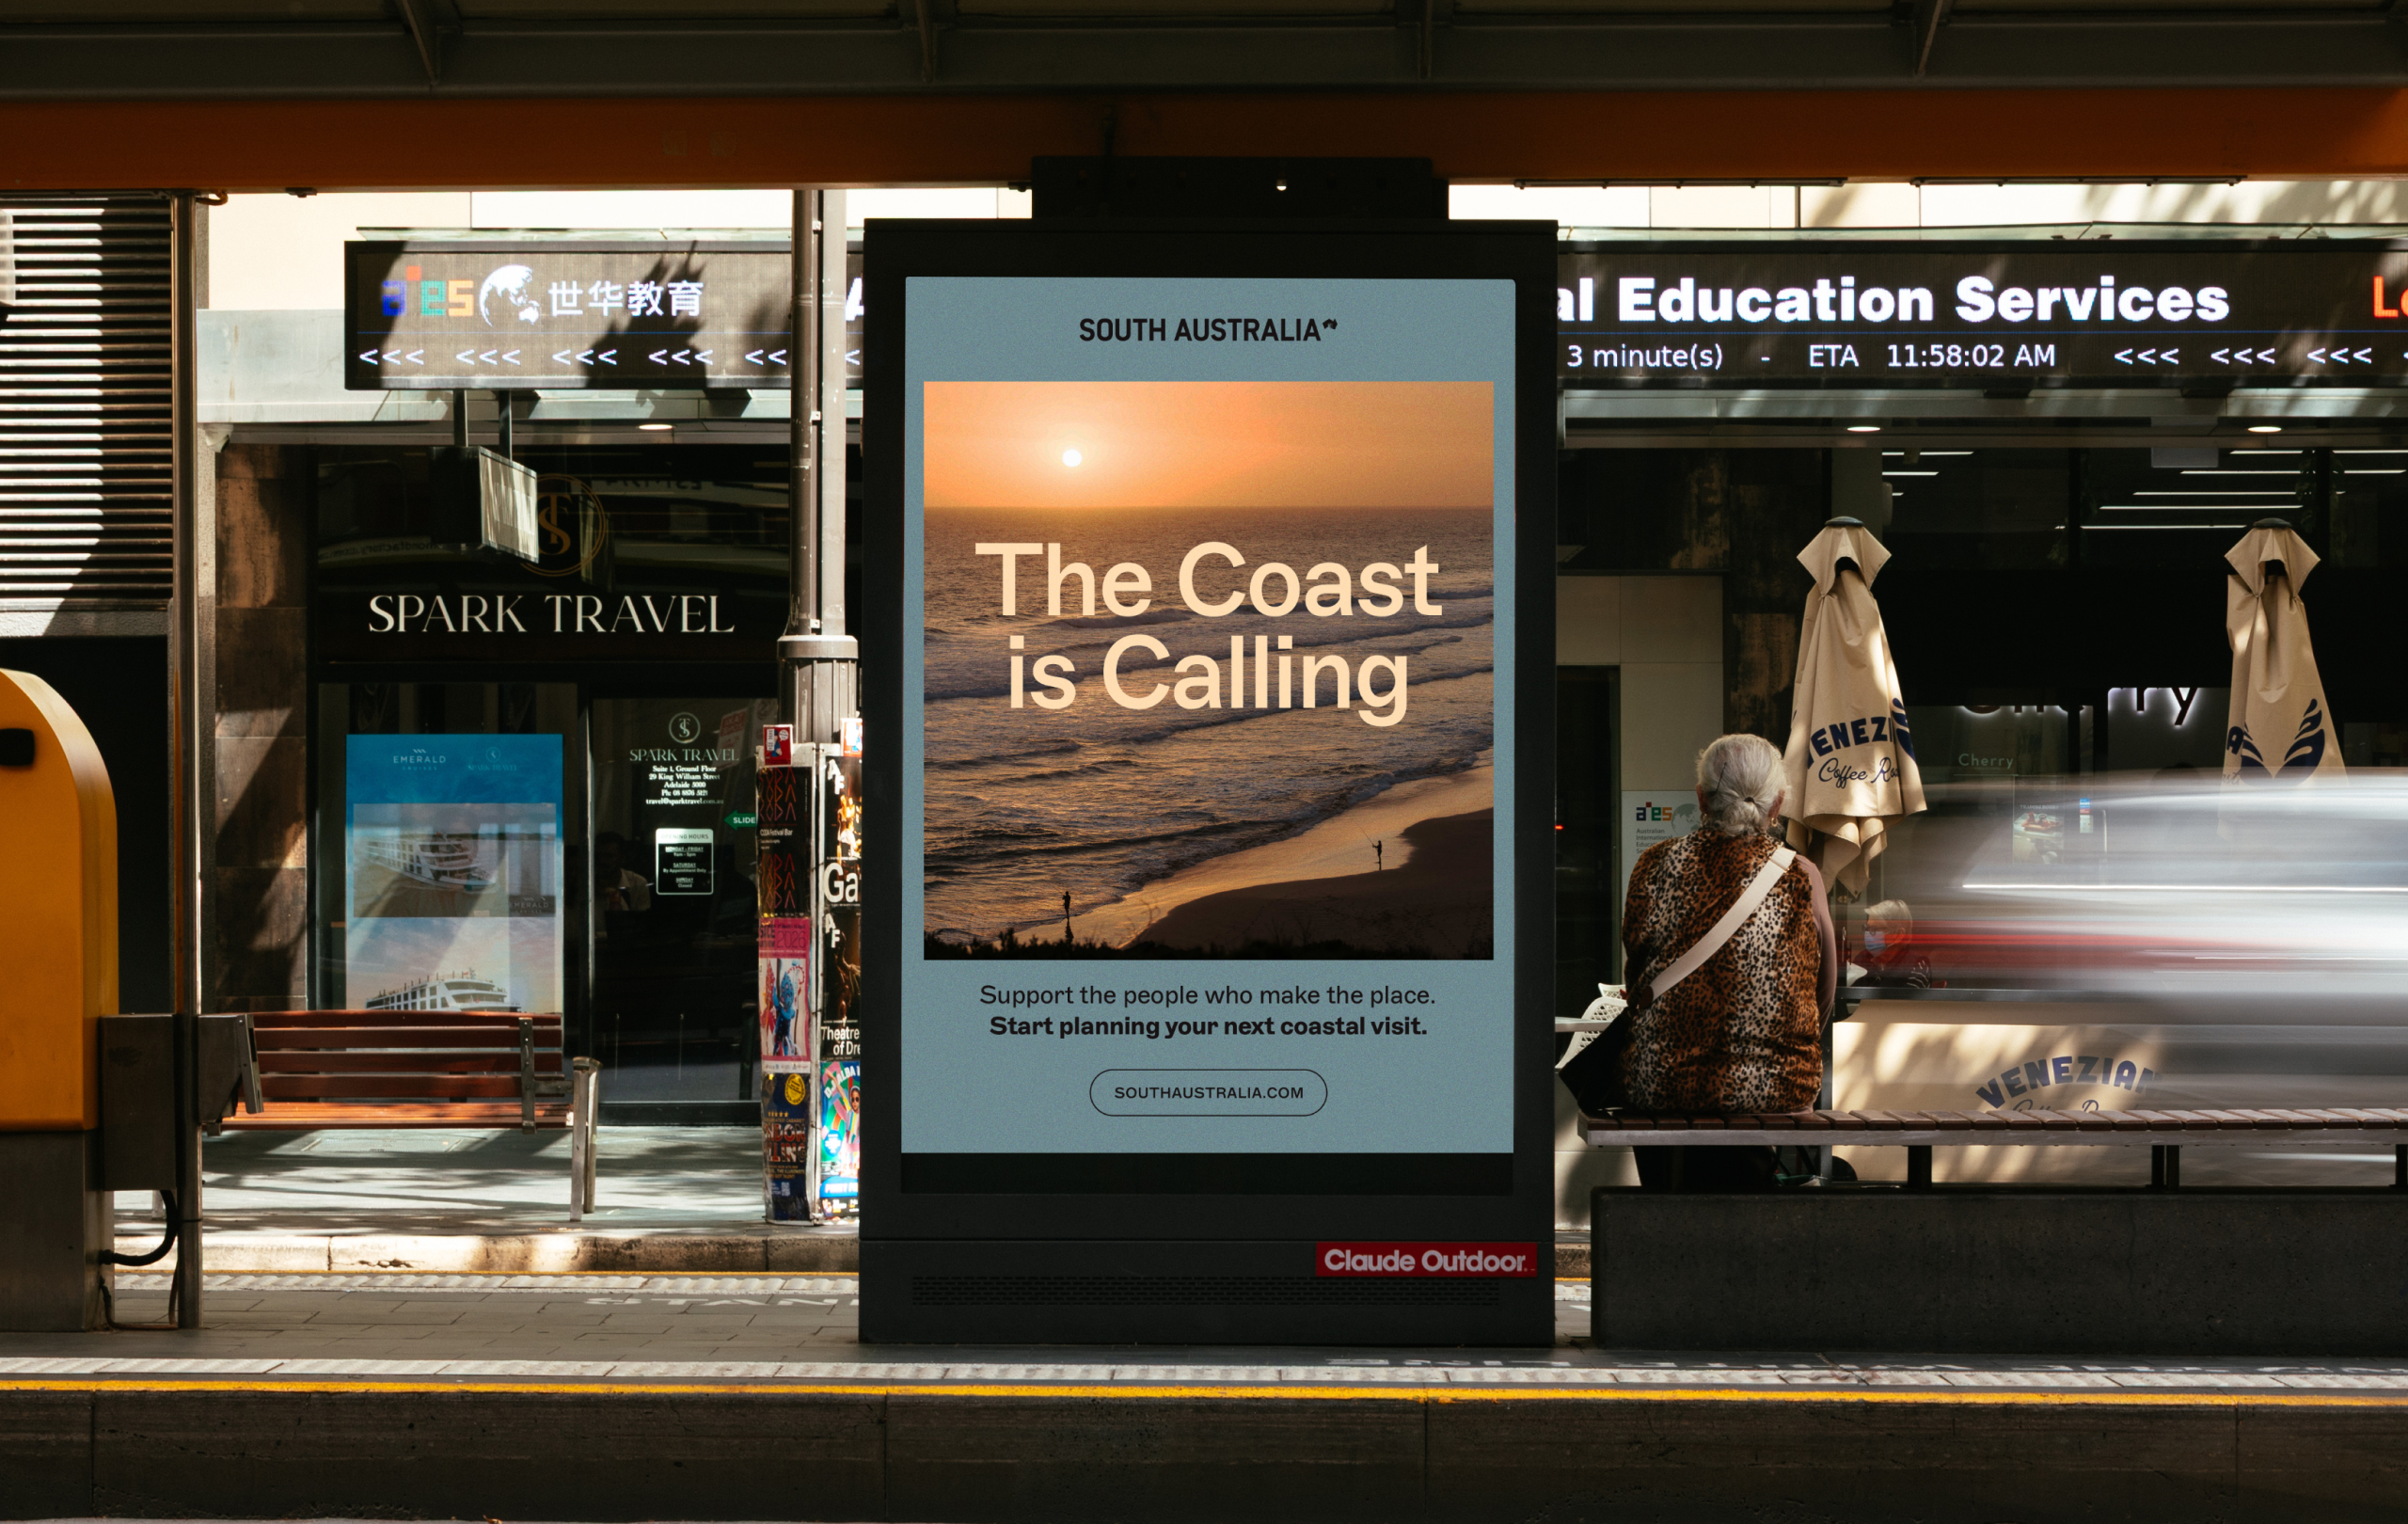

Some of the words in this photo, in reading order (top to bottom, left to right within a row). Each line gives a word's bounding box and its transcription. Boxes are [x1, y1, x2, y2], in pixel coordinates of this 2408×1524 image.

[547, 279, 704, 317] 世华教育
[1618, 277, 1934, 322] Education
[1956, 276, 2230, 322] Services
[1080, 318, 1165, 341] SOUTH
[1174, 318, 1321, 341] AUSTRALIA
[1568, 345, 1582, 367] 3
[1594, 343, 1722, 370] minute(s)
[1810, 345, 1859, 366] ETA
[1888, 344, 2004, 366] 11:58:02
[2014, 344, 2054, 366] AM
[975, 542, 1152, 616] The
[1179, 541, 1442, 617] Coast
[370, 595, 526, 631] SPARK
[546, 595, 734, 632] TRAVEL
[1009, 635, 1076, 709] is
[1102, 634, 1407, 726] Calling
[393, 755, 446, 764] EMERALD
[629, 749, 677, 761] SPARK
[682, 749, 739, 761] TRAVEL
[1958, 754, 2014, 770] Cherry
[658, 773, 673, 782] King
[1818, 757, 1867, 788] Coffee
[777, 930, 806, 948] 2026
[980, 985, 1073, 1008] Support
[1080, 986, 1116, 1004] the
[1125, 986, 1197, 1008] people
[1205, 986, 1252, 1004] who
[1260, 986, 1320, 1004] make
[1326, 986, 1363, 1004] the
[1371, 986, 1434, 1008] place.
[820, 1025, 860, 1040] Theatre
[990, 1016, 1054, 1035] Start
[1060, 1017, 1159, 1039] planning
[1165, 1022, 1218, 1039] your
[1225, 1017, 1275, 1035] next
[1281, 1017, 1365, 1035] coastal
[1370, 1017, 1427, 1035] visit.
[832, 1040, 845, 1056] of
[1115, 1087, 1303, 1098] SOUTHAUSTRALIA.COM
[1324, 1249, 1415, 1271] Claude
